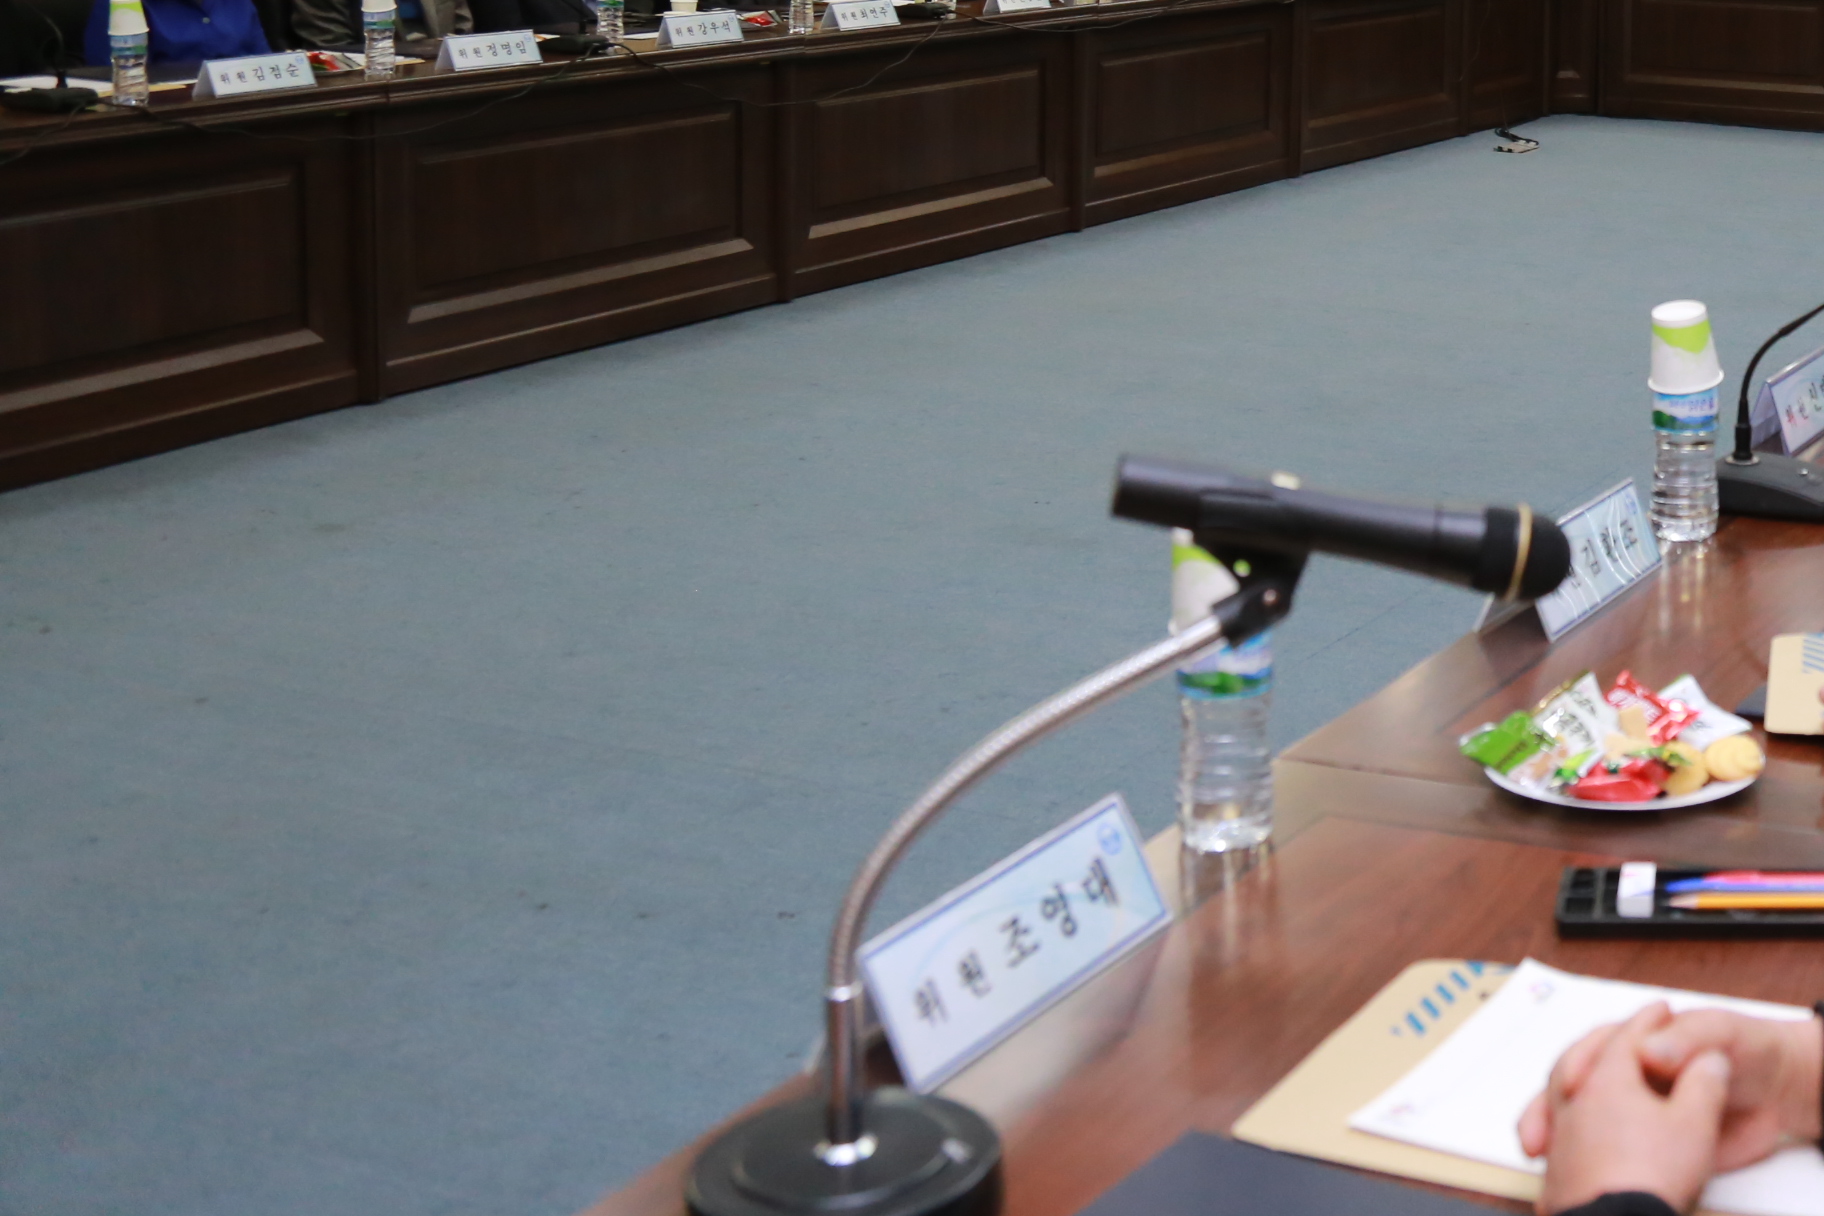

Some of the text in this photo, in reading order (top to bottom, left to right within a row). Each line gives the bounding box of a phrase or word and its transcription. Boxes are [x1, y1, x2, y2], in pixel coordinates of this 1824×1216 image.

[458, 47, 483, 60] 위원
[220, 71, 248, 85] 위원
[913, 855, 1121, 1029] 위원 조영대
